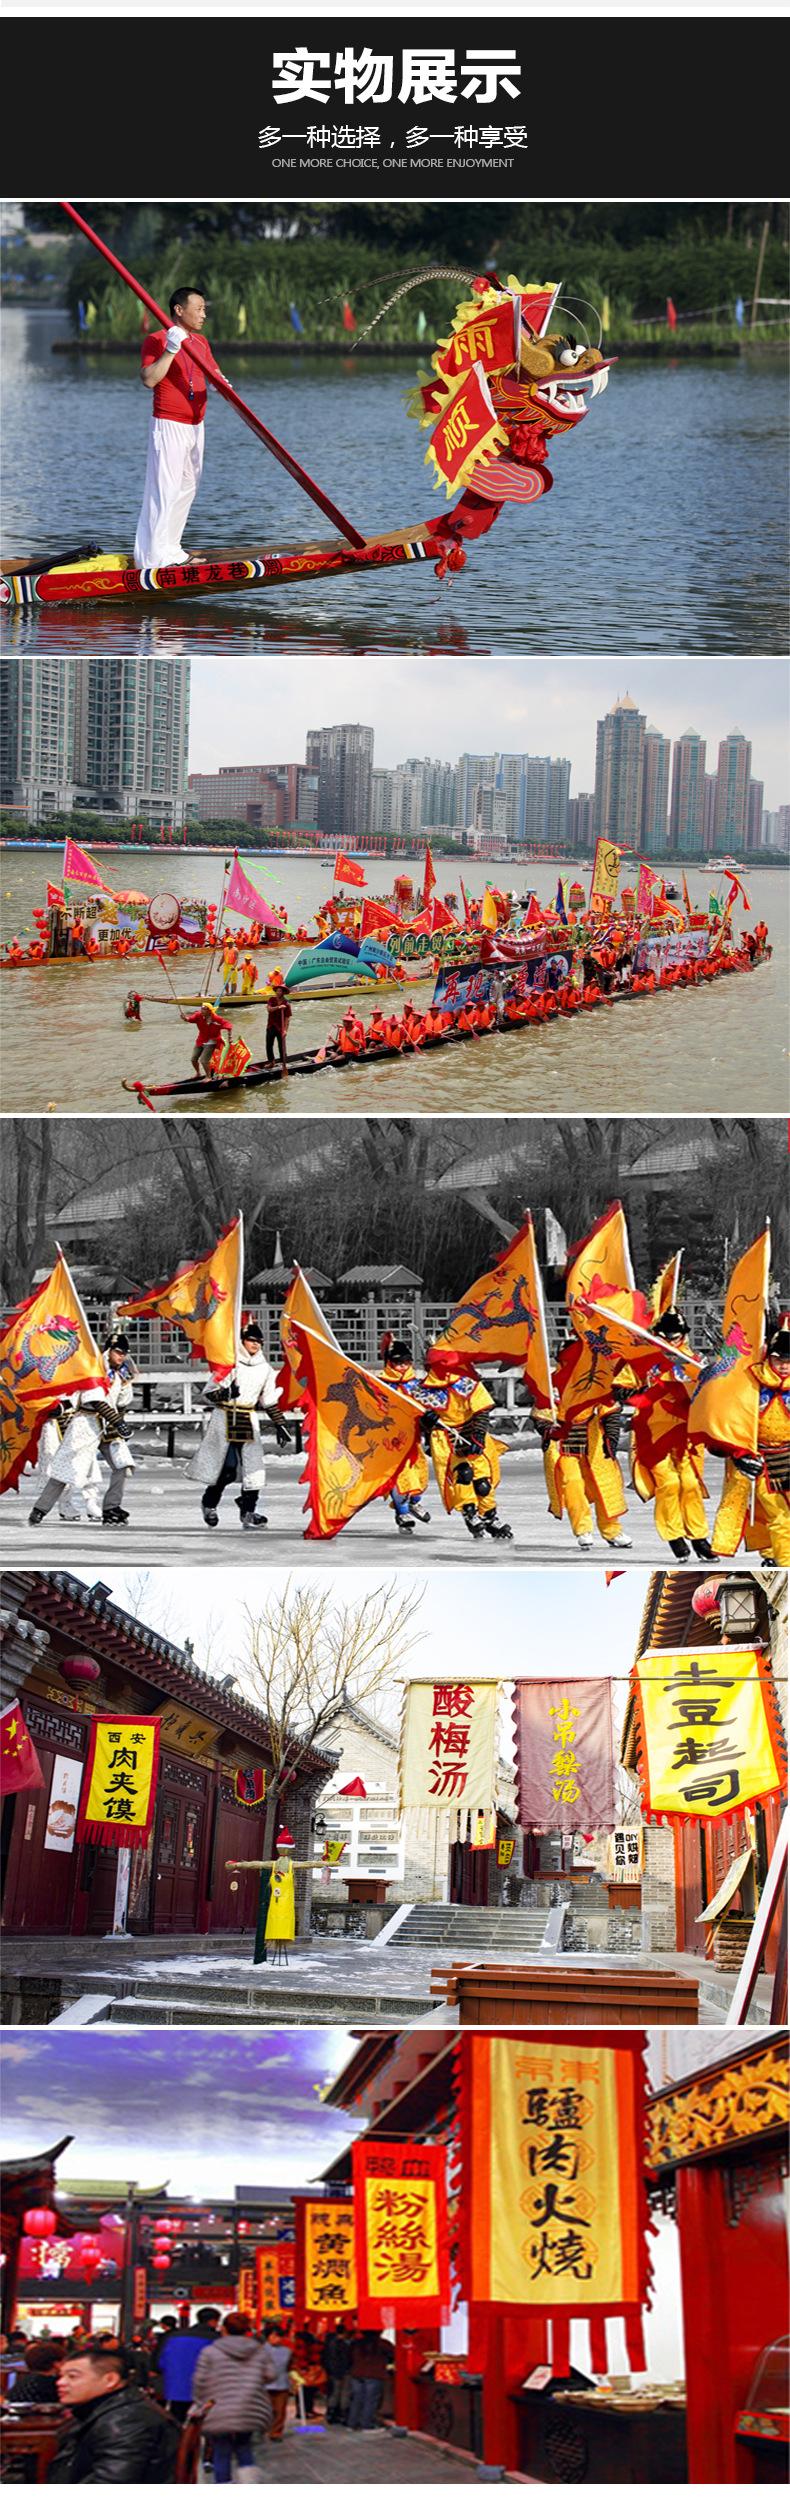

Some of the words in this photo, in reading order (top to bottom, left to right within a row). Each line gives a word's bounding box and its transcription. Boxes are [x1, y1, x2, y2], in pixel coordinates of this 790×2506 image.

[453, 317, 499, 366] 雨
[443, 396, 480, 462] 顺
[159, 561, 247, 586] 南塘龙巷
[60, 898, 119, 926] 不断超越
[97, 918, 151, 949] 更加优秀
[107, 1732, 147, 1745] 西安
[428, 1683, 476, 1798] 酸梅汤
[548, 1698, 582, 1804] 小吊梨汤
[662, 1661, 747, 1807] 土豆起司
[103, 1746, 139, 1822] 肉夹馍
